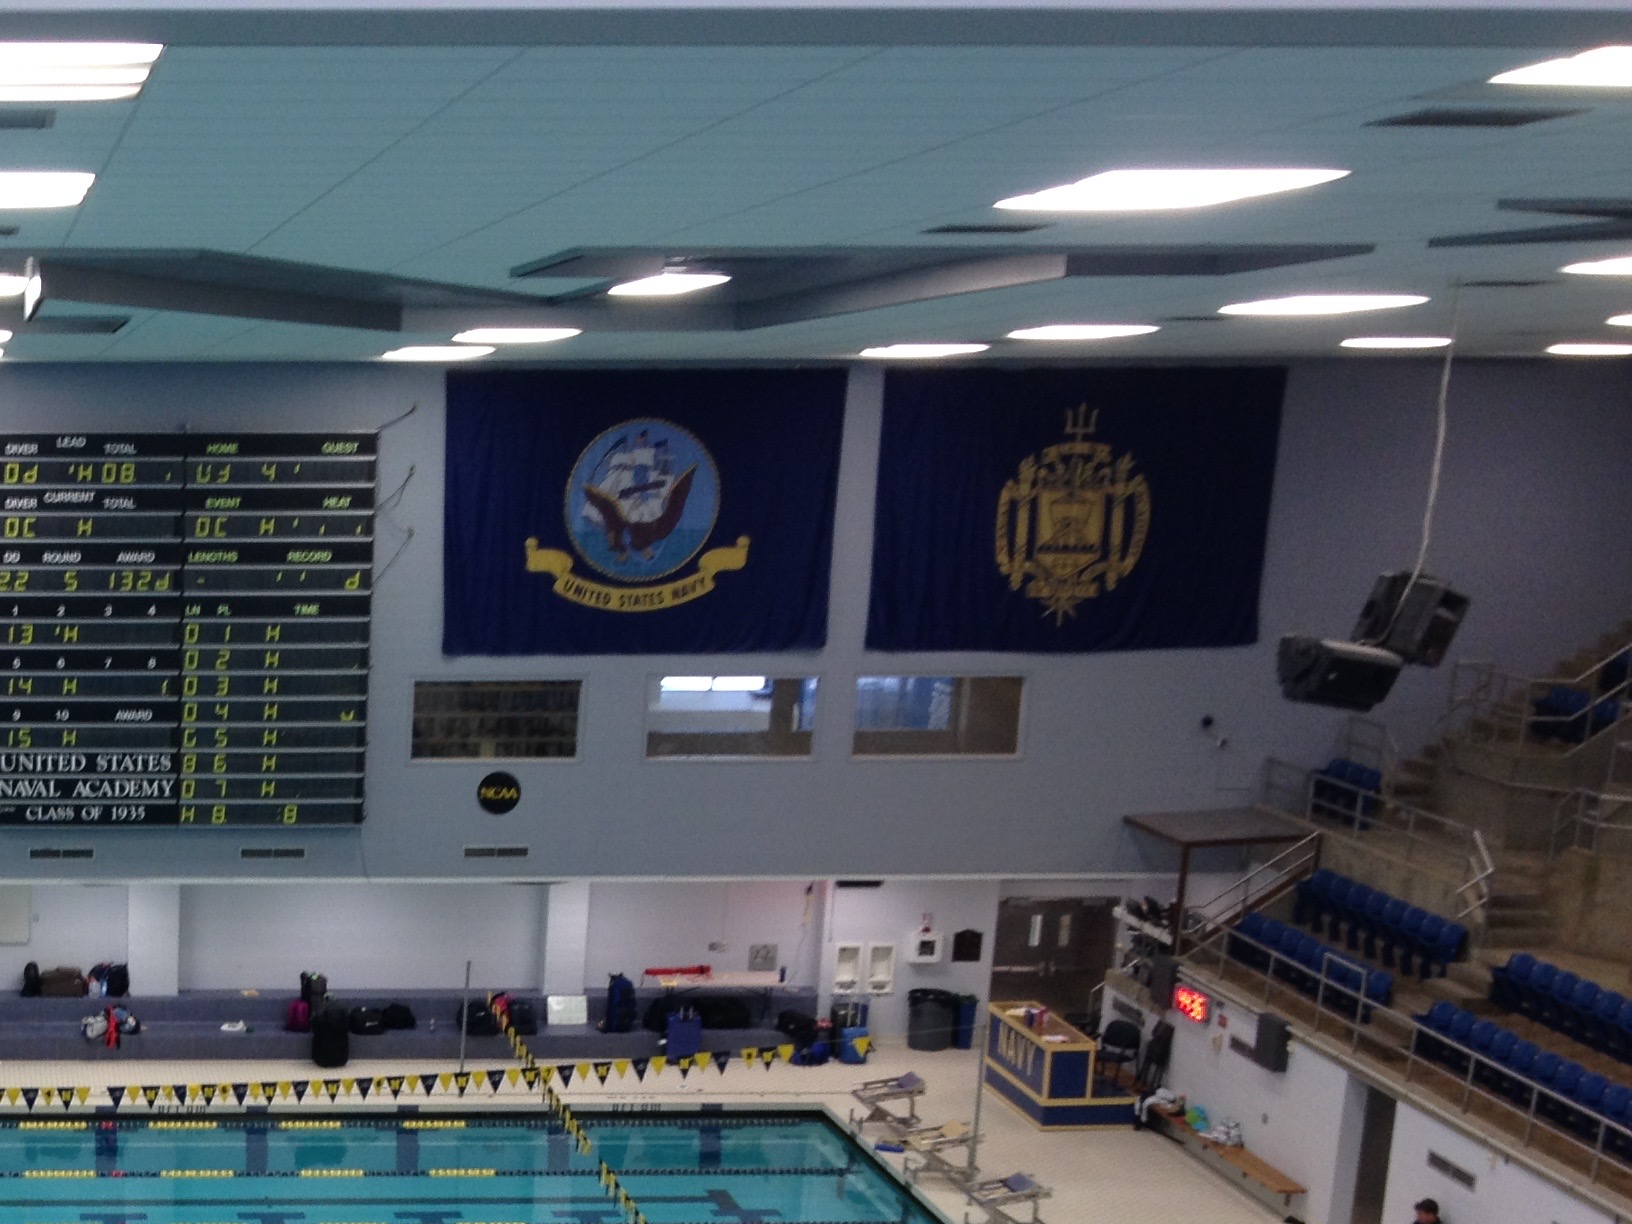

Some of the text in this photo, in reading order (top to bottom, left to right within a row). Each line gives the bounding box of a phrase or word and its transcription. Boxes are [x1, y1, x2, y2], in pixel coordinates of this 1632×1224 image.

[56, 436, 86, 448] LEAD
[206, 442, 359, 455] HOME GUEST
[5, 443, 137, 455] DIVER TOTAL
[44, 491, 96, 503] CURRENT
[205, 496, 352, 509] EVENT HEAT
[5, 498, 136, 510] DIVER TOTAL
[42, 551, 81, 563] ROUND
[116, 551, 155, 563] AWARD
[188, 550, 333, 563] LENGTHS RECORD
[563, 576, 707, 608] UNITED STATES NAVY
[293, 603, 320, 616] TIME
[115, 709, 153, 722] AWARD
[0, 754, 172, 773] UNITED STATES
[72, 779, 175, 798] ACADEMY
[480, 787, 518, 799] NCAA
[25, 806, 75, 821] CLASS
[81, 806, 103, 821] OF
[111, 806, 146, 821] 1935
[997, 1020, 1037, 1077] NAVY
